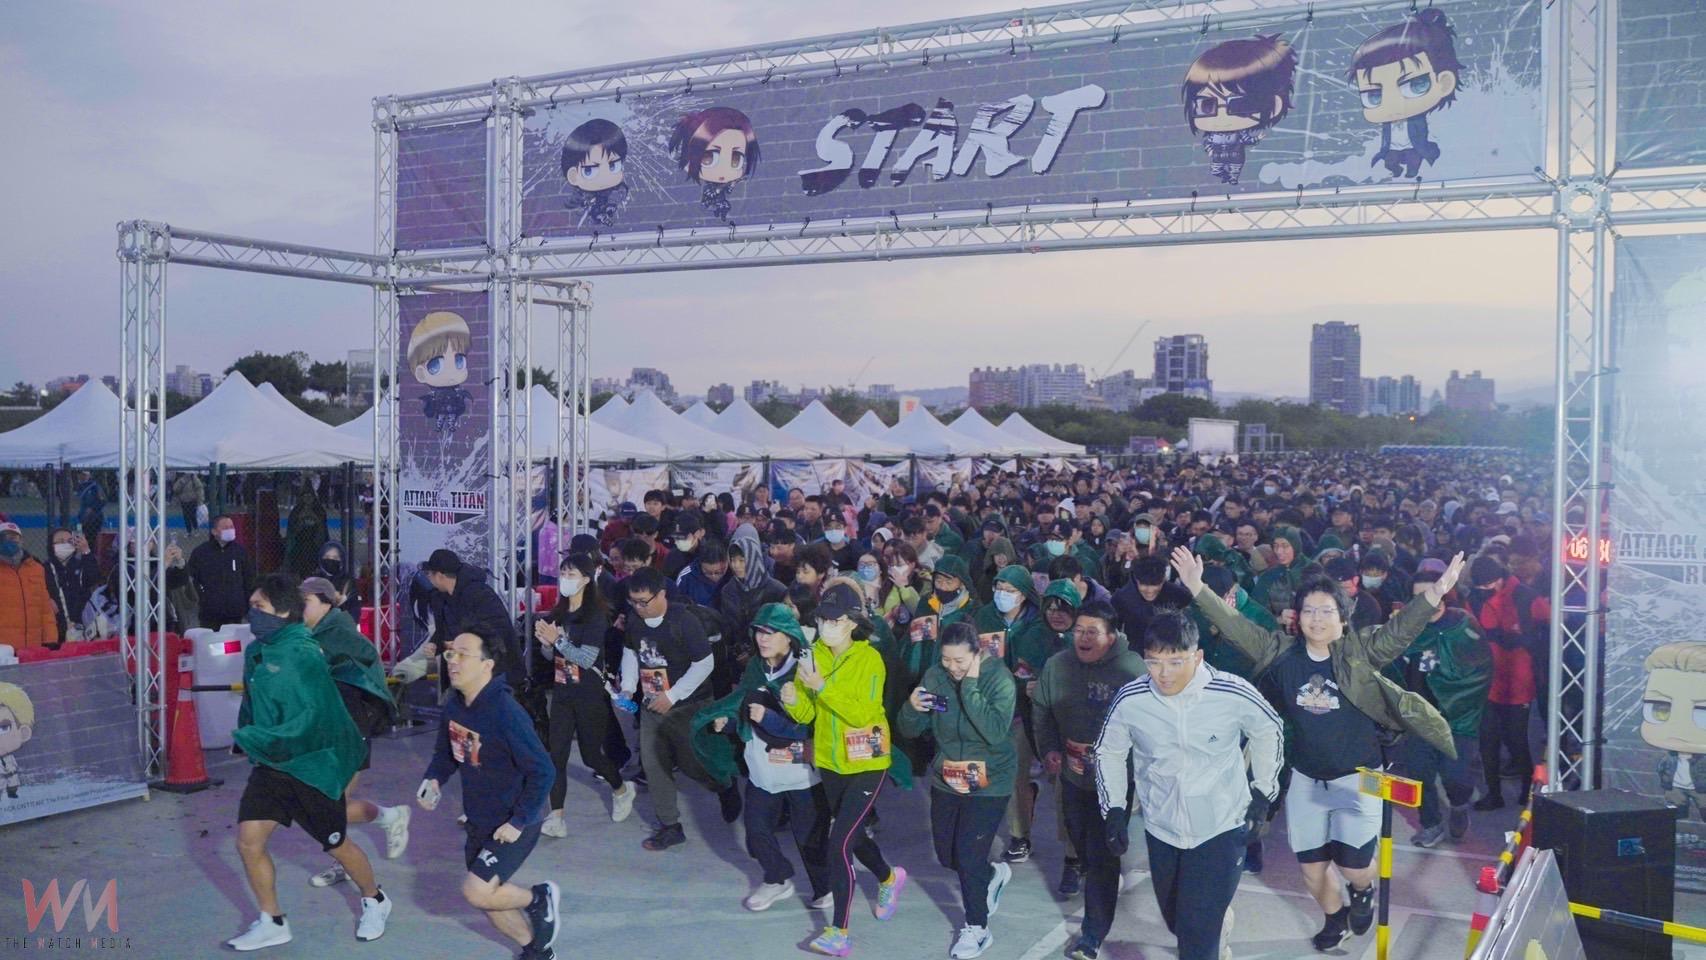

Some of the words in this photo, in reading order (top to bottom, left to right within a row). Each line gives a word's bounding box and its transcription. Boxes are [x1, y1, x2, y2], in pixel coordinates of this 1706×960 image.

[797, 83, 1107, 196] START
[403, 490, 438, 507] ATTACK
[450, 491, 485, 509] TITAN
[432, 510, 454, 525] RUN
[1620, 532, 1698, 559] ATTACK
